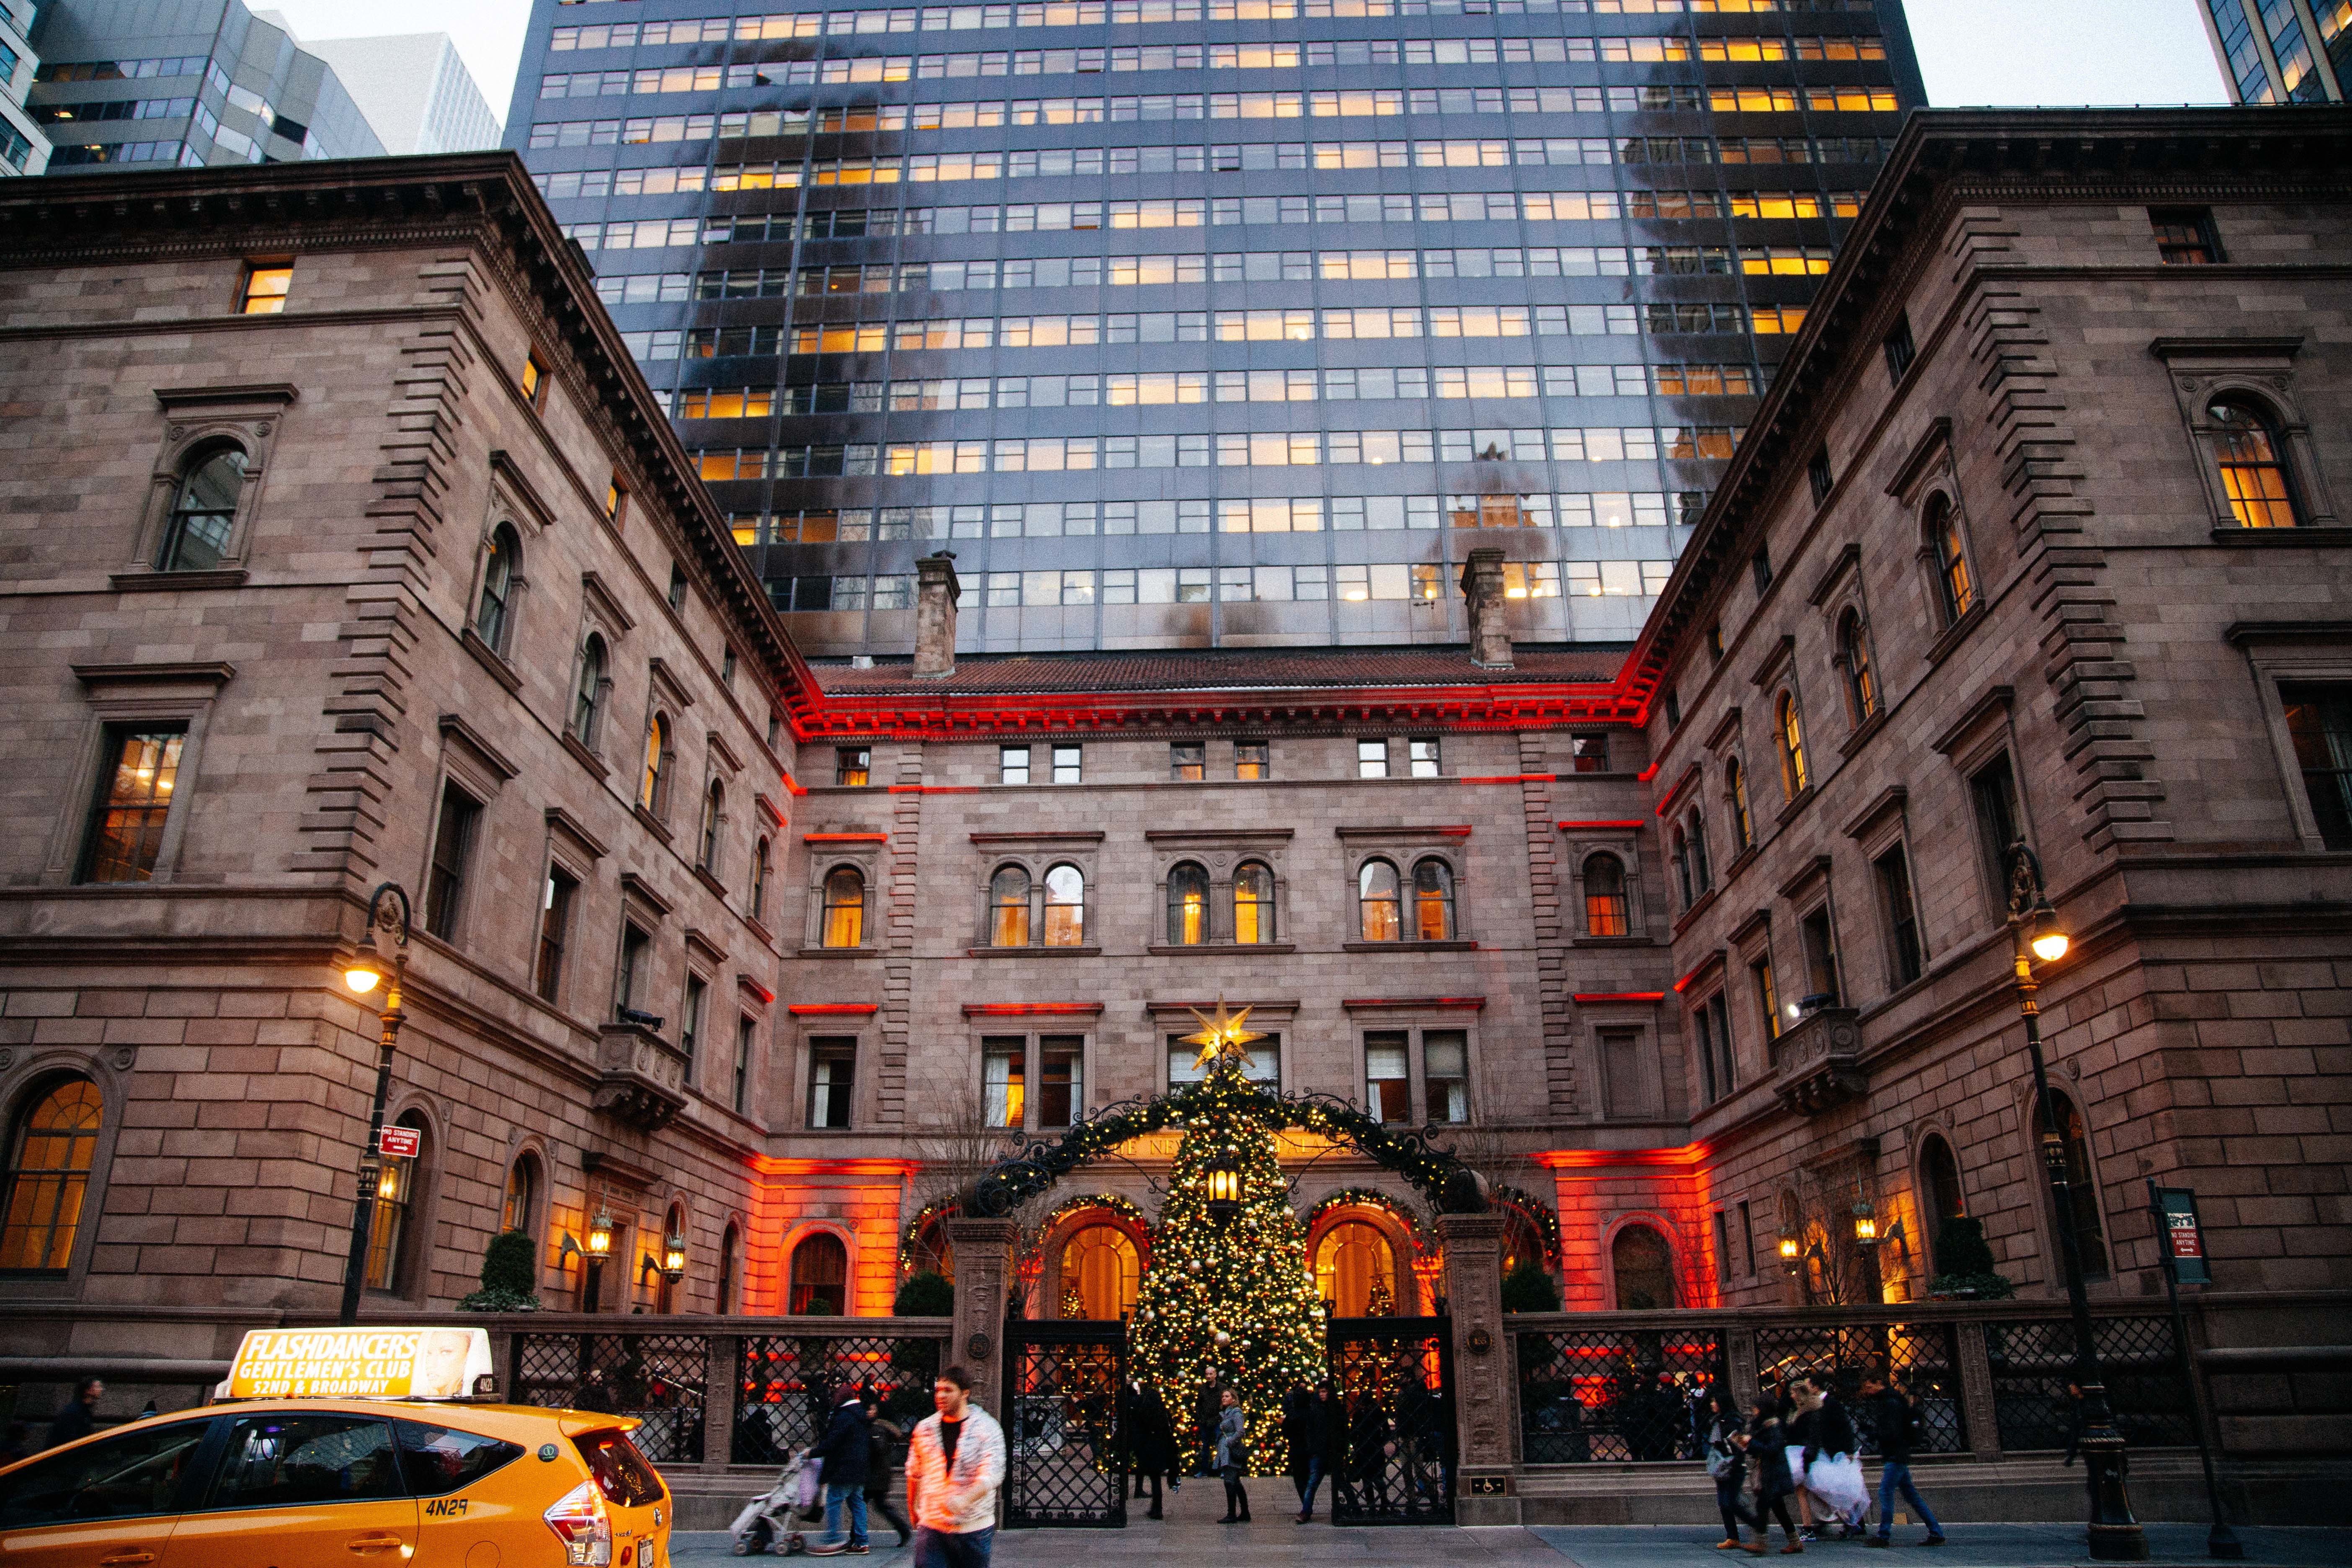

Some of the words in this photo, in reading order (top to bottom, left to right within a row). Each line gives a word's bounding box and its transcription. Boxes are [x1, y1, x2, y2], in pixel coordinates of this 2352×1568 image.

[387, 1136, 413, 1145] ANYTIME
[394, 1130, 418, 1138] STANDING
[245, 1334, 419, 1360] FLASHDANCERS
[240, 1360, 361, 1379] GENTLEMEN'S
[366, 1360, 411, 1378] CLUB
[252, 1380, 290, 1394] 52ND
[294, 1380, 306, 1394] &
[310, 1380, 390, 1394] BROADWAY
[480, 1378, 493, 1392] 4N29
[426, 1499, 468, 1516] 4N29
